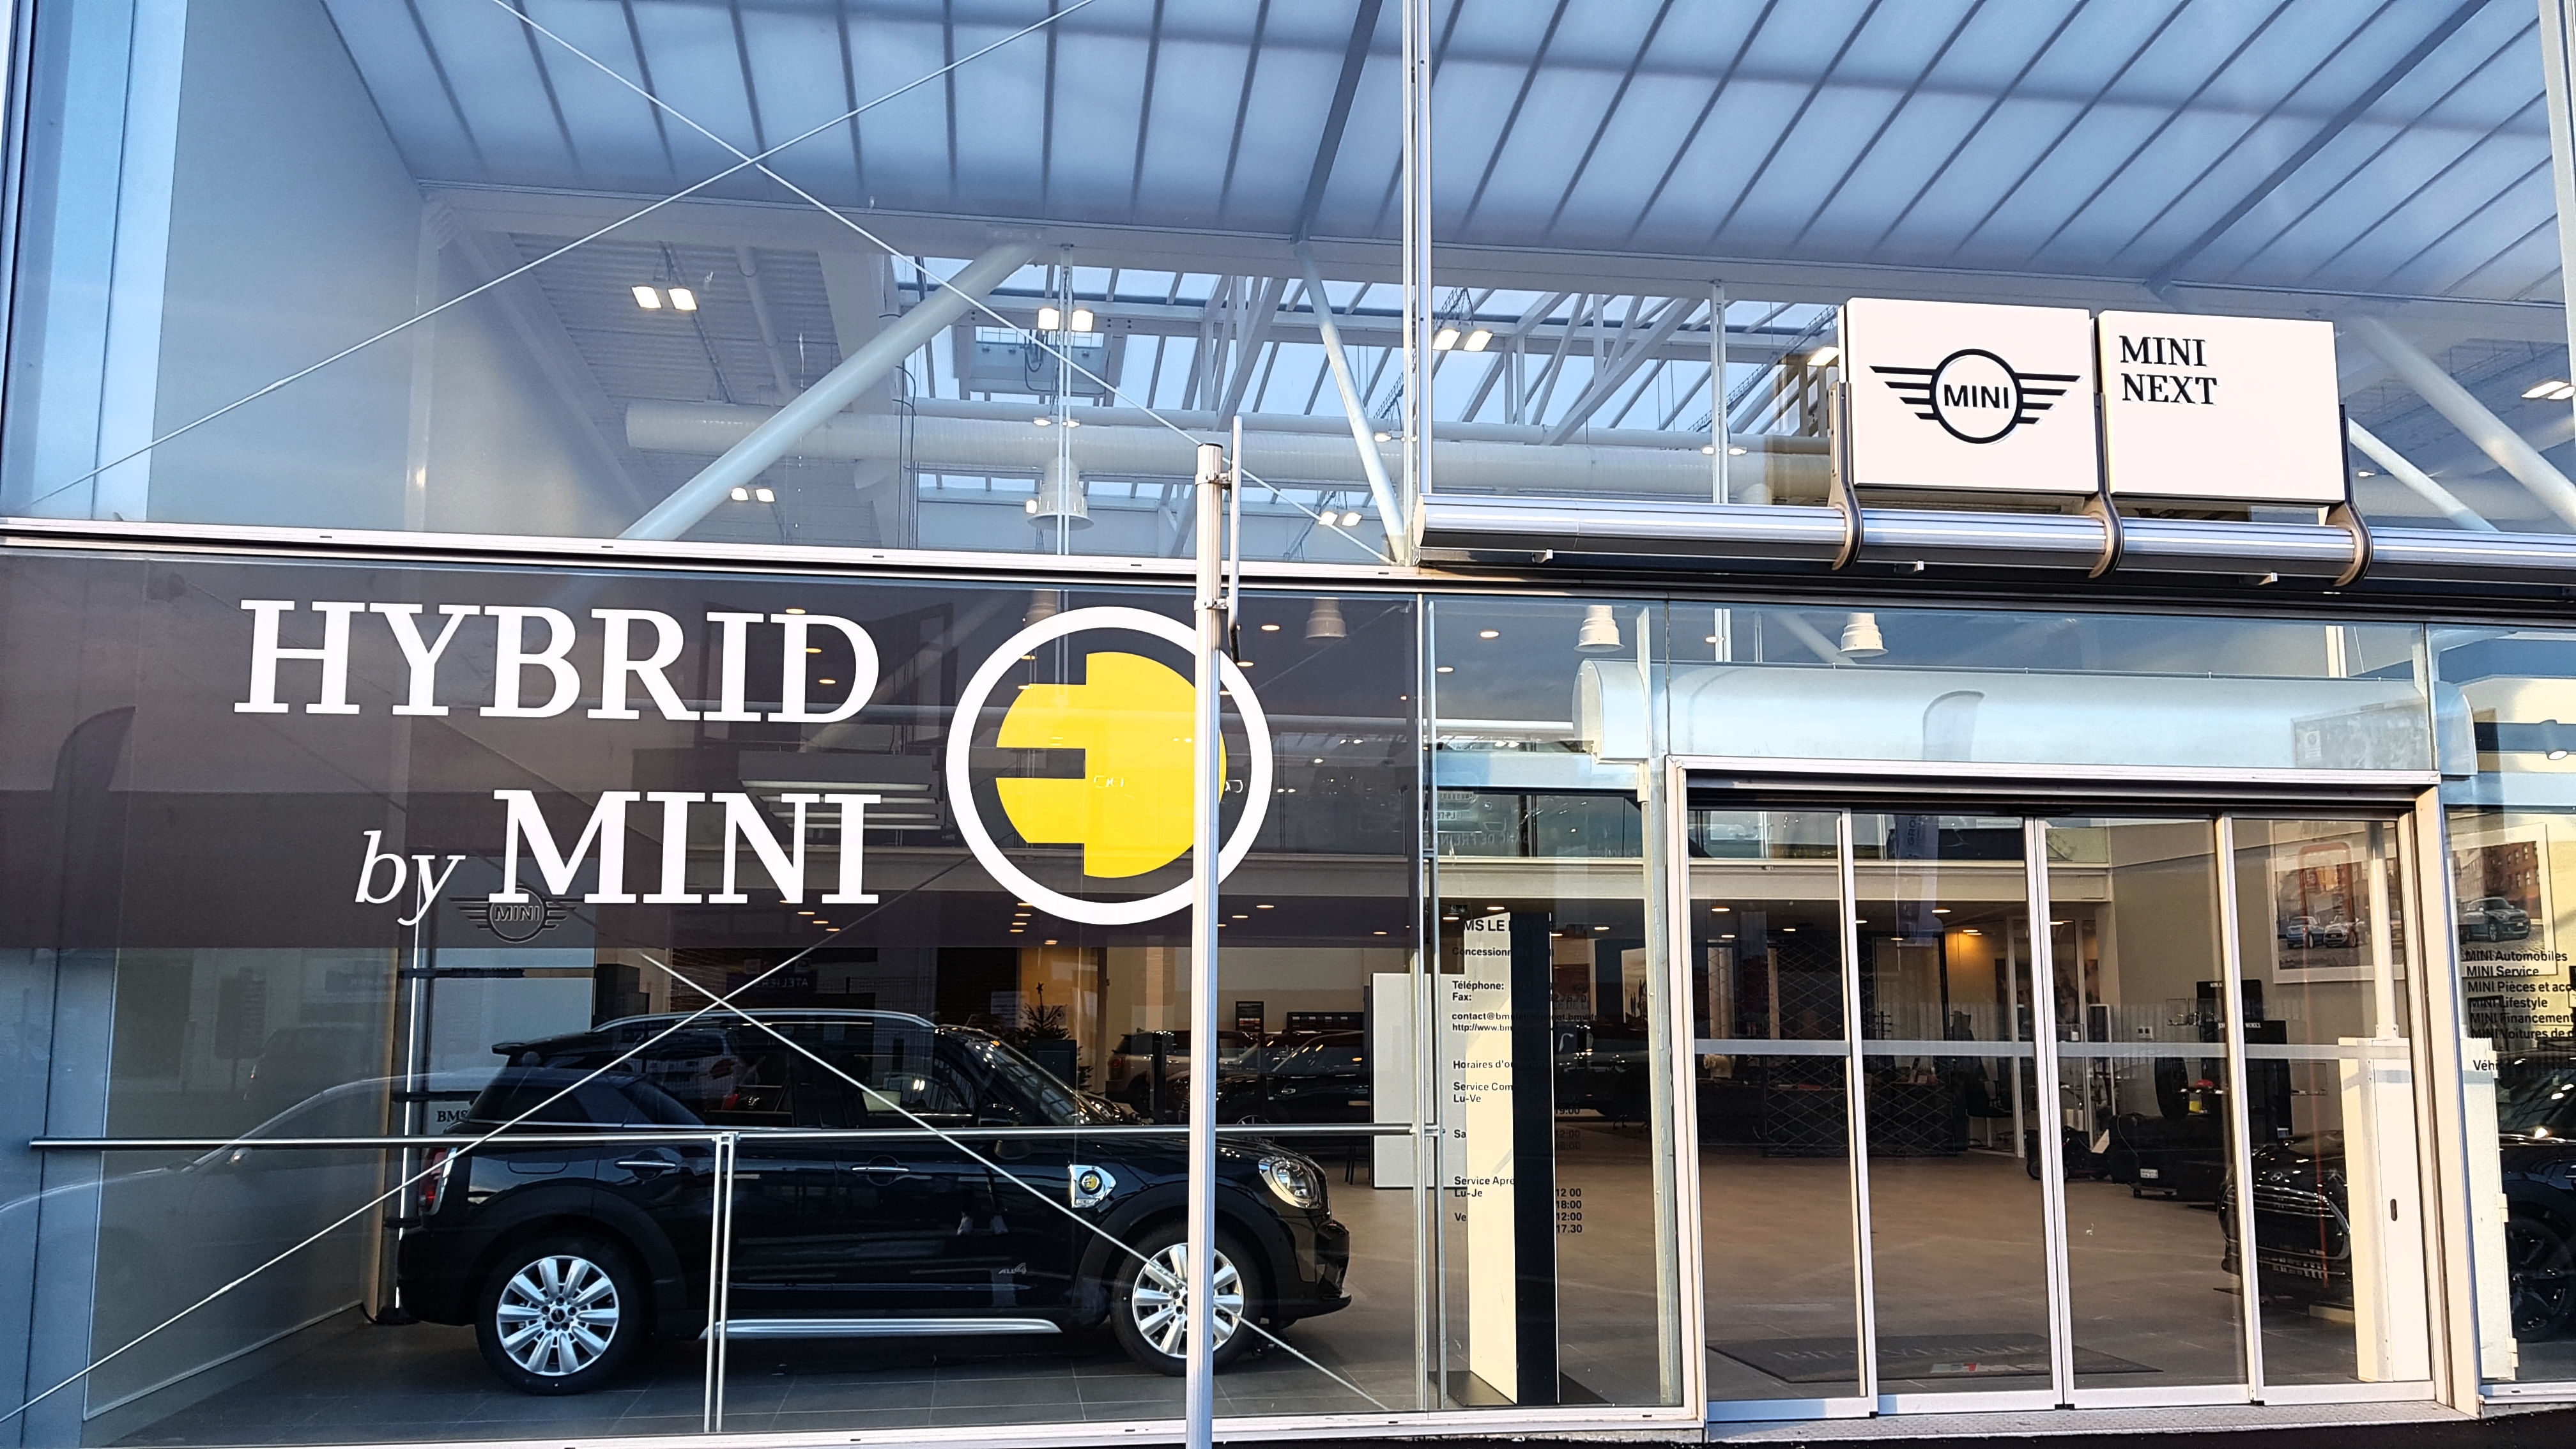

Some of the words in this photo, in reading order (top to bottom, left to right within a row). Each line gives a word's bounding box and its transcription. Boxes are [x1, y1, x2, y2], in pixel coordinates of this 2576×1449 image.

[2119, 335, 2207, 366] MINI
[2121, 374, 2218, 405] NEXT
[1943, 383, 2009, 409] MINI
[234, 599, 879, 723] HYBRID
[355, 830, 466, 926] by
[489, 789, 881, 905] MINI
[494, 905, 540, 921] MINI
[1488, 920, 1505, 931] LE
[2466, 951, 2492, 961] MINI
[2495, 950, 2568, 961] Automobiles
[2467, 965, 2493, 976] MINI
[2496, 965, 2539, 977] Service
[1452, 980, 1504, 991] Téléphone:
[2467, 981, 2495, 992] MINI
[2497, 981, 2536, 992] Pièces
[2538, 982, 2550, 992] et
[1452, 992, 1472, 1001] Fax:
[2470, 998, 2496, 1008] MINI
[2499, 996, 2548, 1010] Lifestyle
[2470, 1013, 2497, 1023] MINI
[2471, 1028, 2498, 1039] MINI
[2501, 1027, 2549, 1039] Voitures
[2551, 1028, 2564, 1038] de
[1453, 1060, 1492, 1069] Horaires
[1453, 1082, 1489, 1091] Service
[1453, 1094, 1481, 1103] Lu-Ve
[1454, 1130, 1467, 1138] Sa
[1454, 1176, 1491, 1185] Service
[1454, 1188, 1483, 1197] Lu-Je
[1556, 1200, 1582, 1209] 18:00
[1454, 1213, 1467, 1222] Ve
[1556, 1213, 1583, 1221] 12:00
